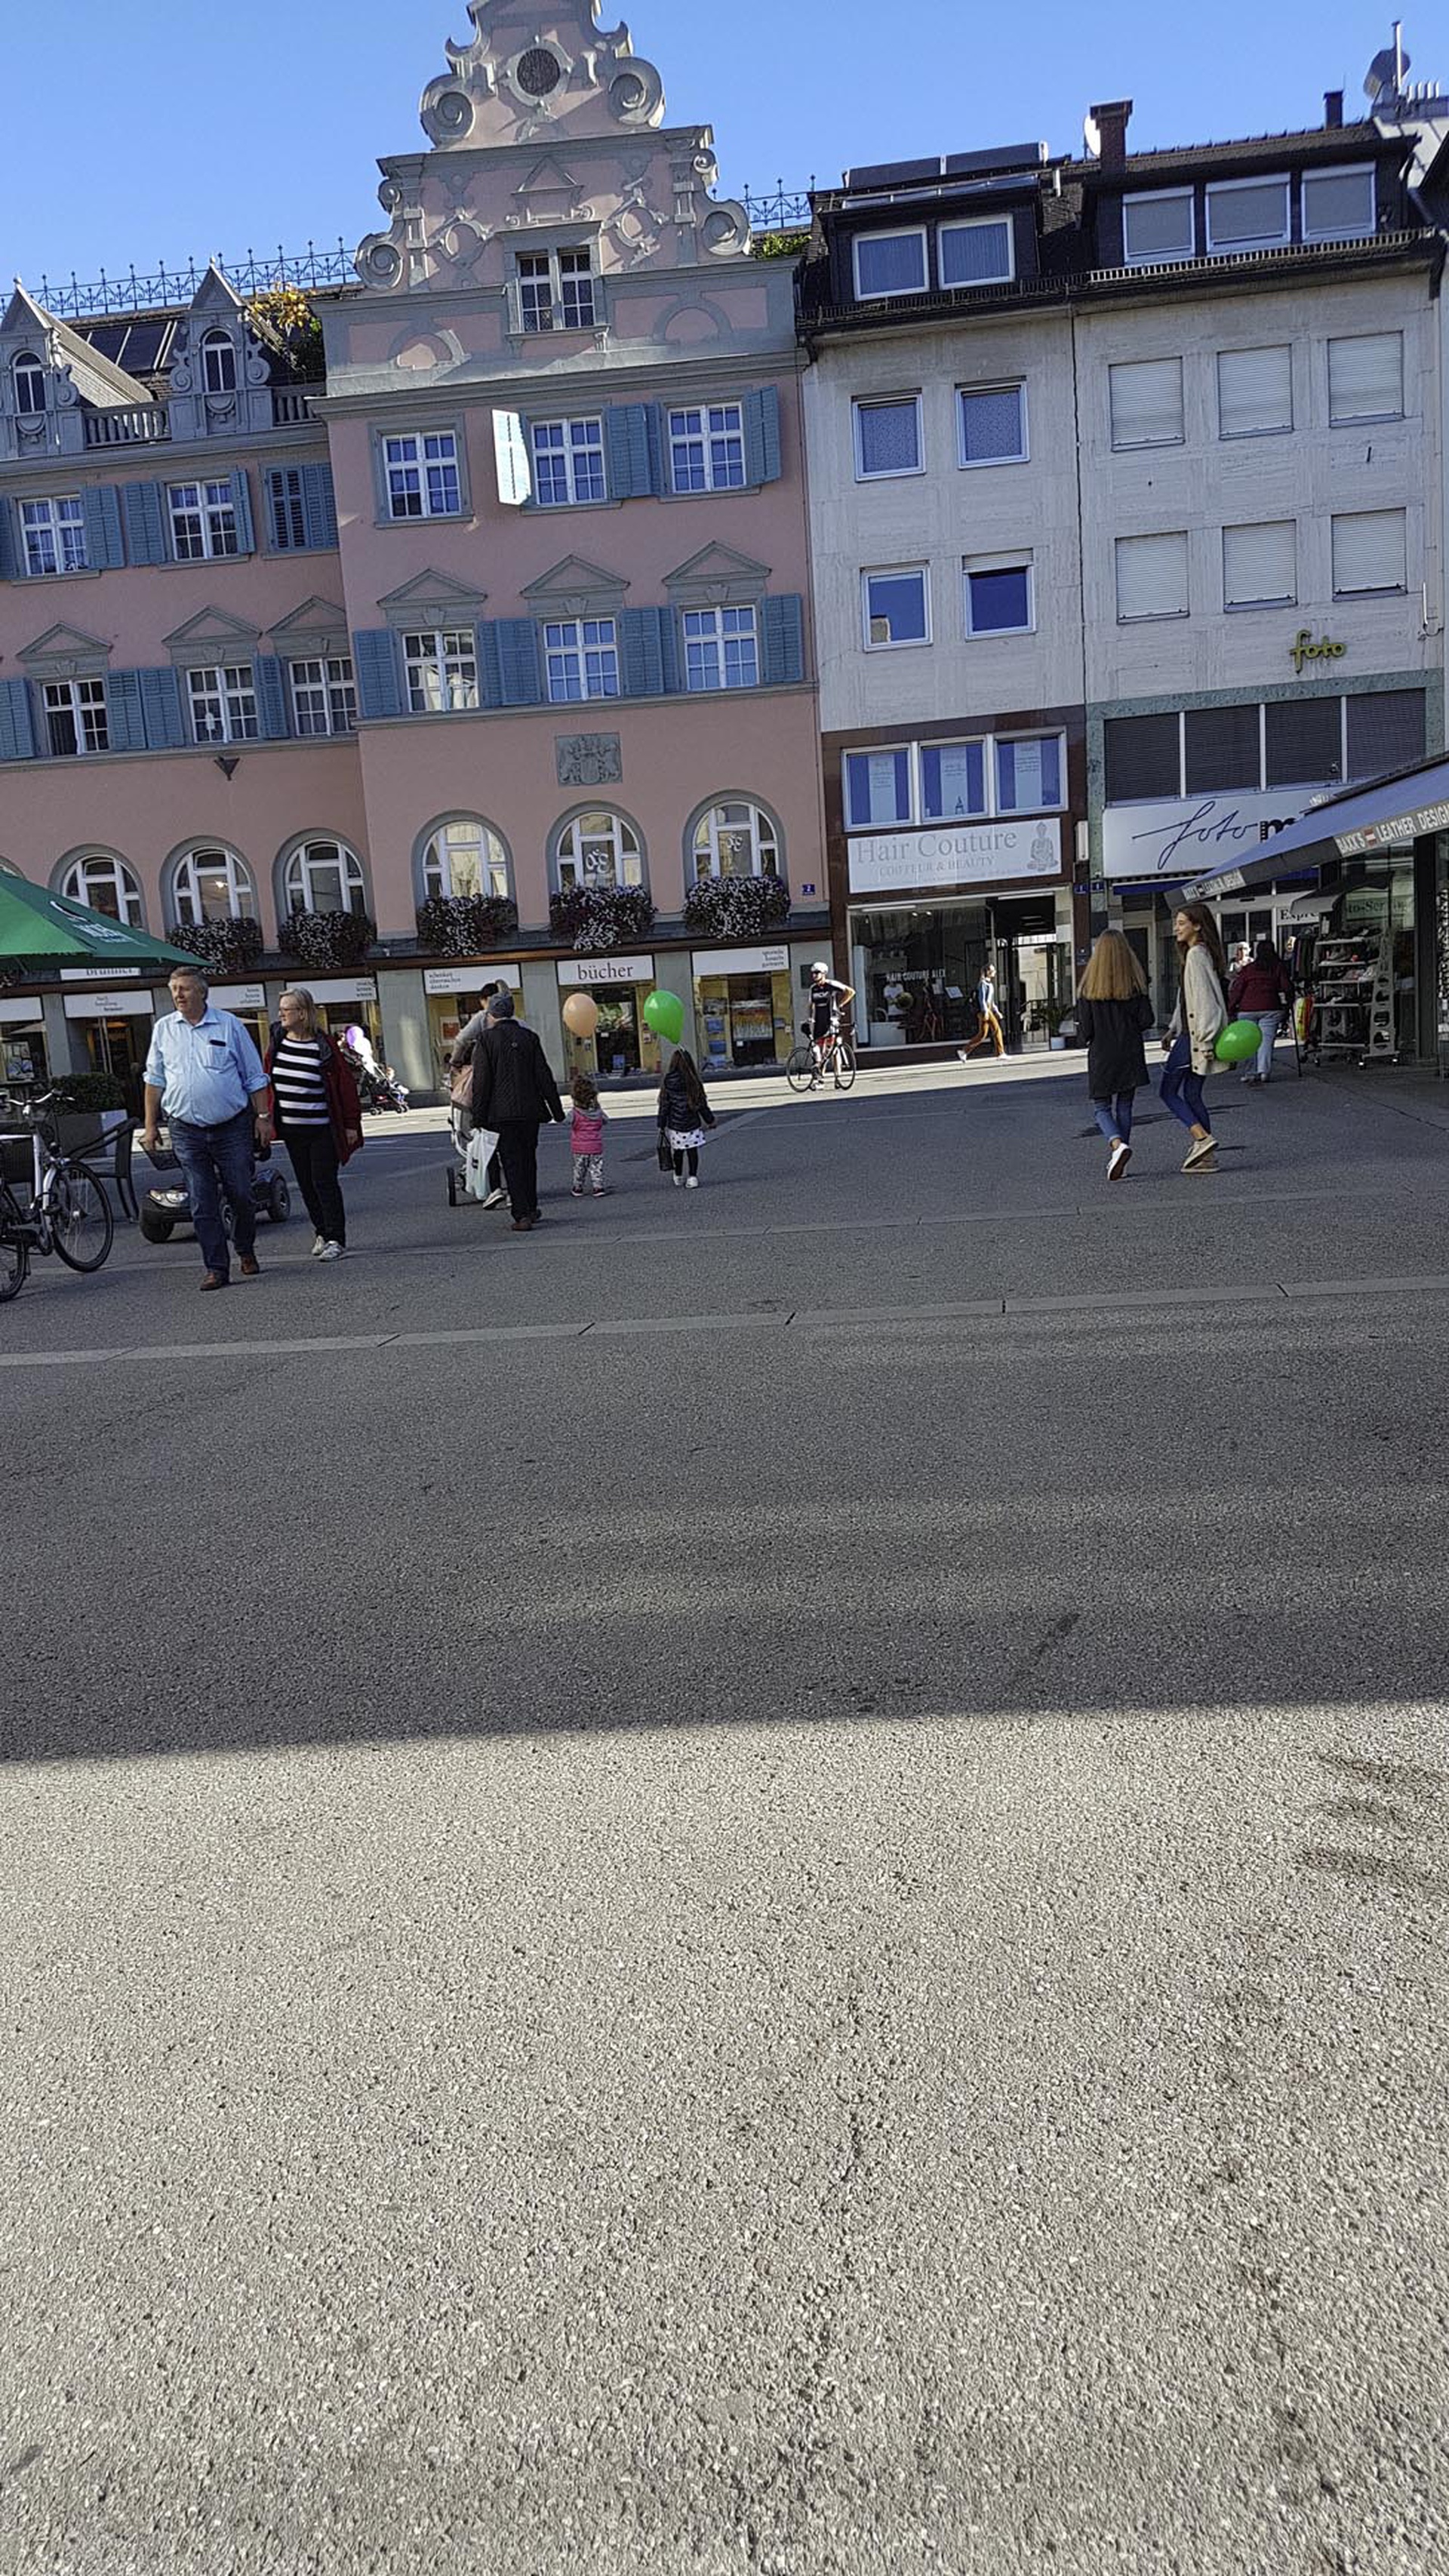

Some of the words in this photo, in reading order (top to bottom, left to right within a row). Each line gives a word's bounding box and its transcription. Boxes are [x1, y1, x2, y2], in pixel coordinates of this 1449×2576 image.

[1288, 629, 1347, 673] foto
[1132, 800, 1258, 869] foto
[1376, 817, 1417, 842] LEATHER
[857, 838, 909, 864] Hair
[918, 832, 1017, 857] Couture
[948, 856, 994, 870] BEAUTY
[577, 962, 634, 980] bücher
